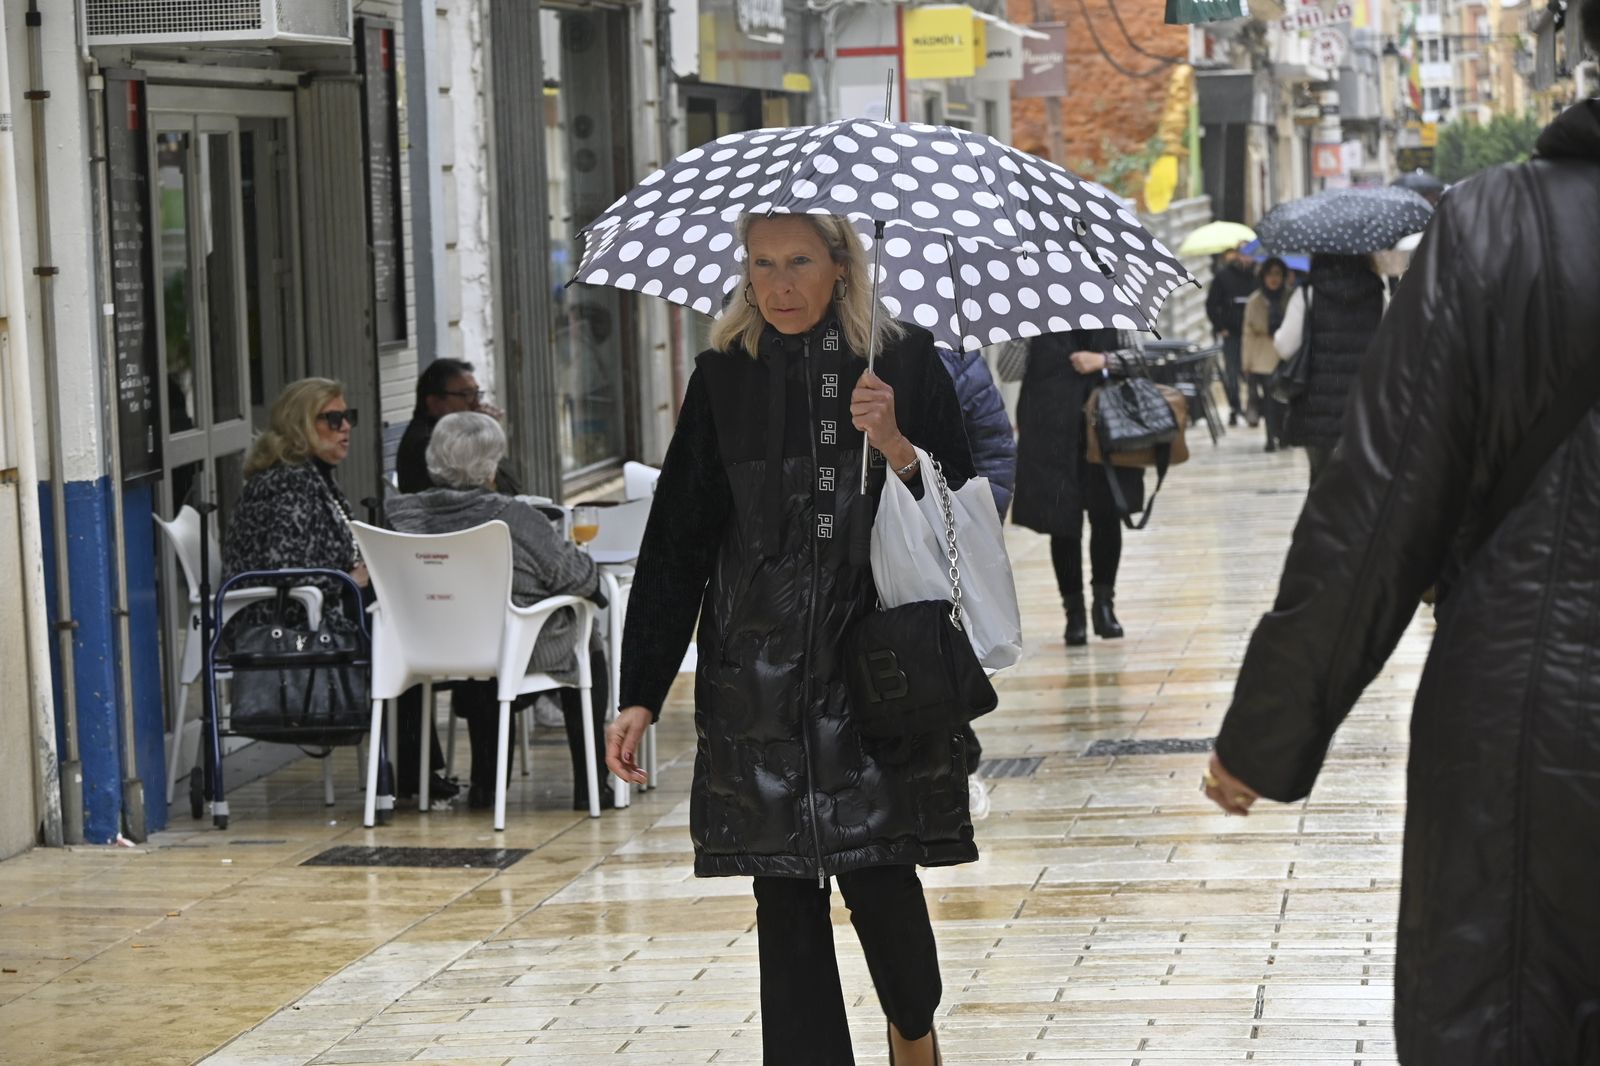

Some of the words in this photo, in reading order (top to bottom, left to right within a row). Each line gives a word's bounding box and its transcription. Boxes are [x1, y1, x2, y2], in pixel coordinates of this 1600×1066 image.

[821, 373, 838, 398] PG
[820, 420, 837, 445] PG
[819, 467, 835, 492] PG
[817, 514, 833, 538] PG
